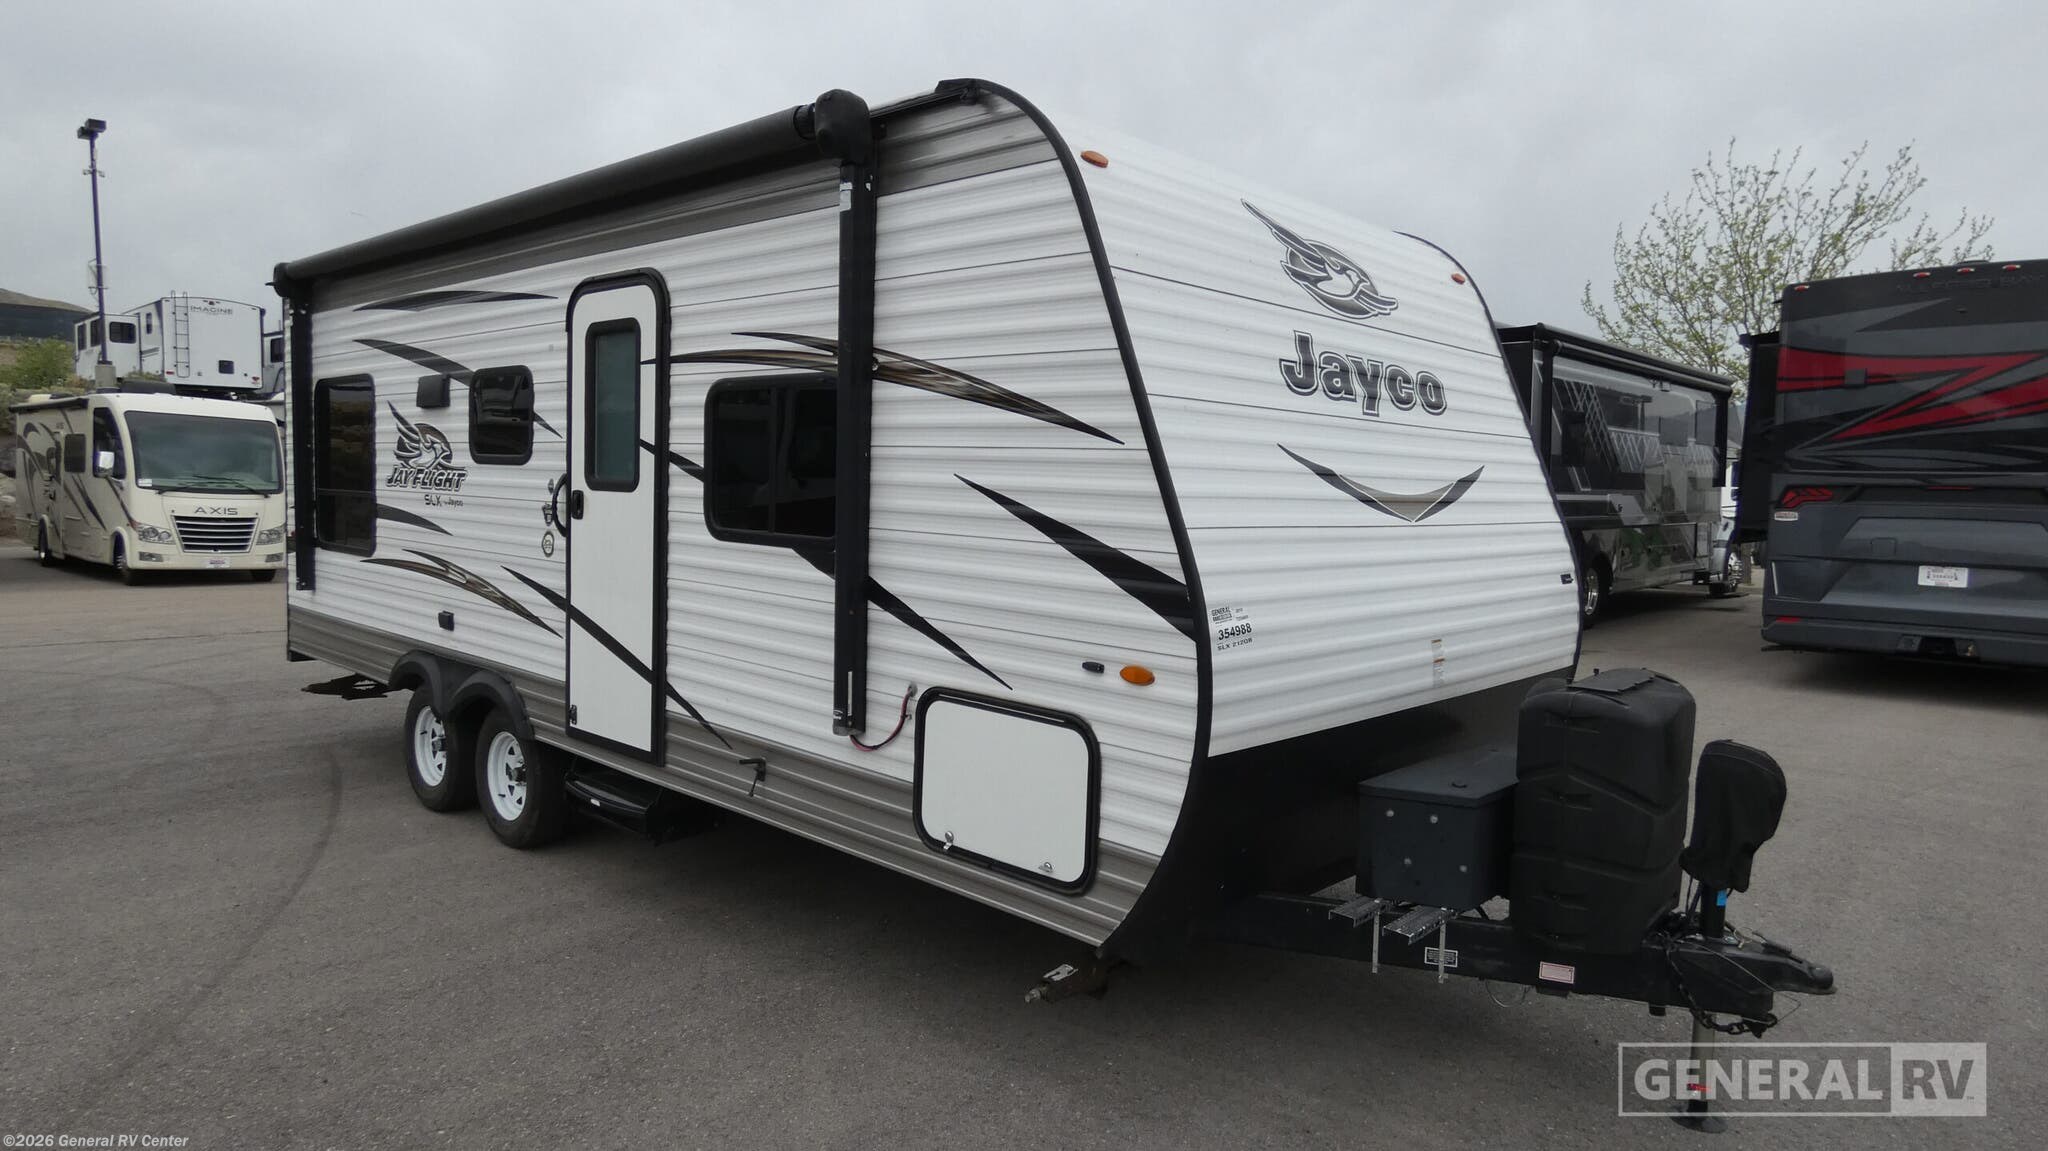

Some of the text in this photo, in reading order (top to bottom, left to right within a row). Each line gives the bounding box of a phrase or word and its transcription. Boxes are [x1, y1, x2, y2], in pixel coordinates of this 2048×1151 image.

[190, 305, 233, 315] IMAGINE
[1279, 330, 1447, 417] Jayco
[387, 465, 467, 492] JAY FLIGHT
[424, 494, 442, 507] SLX
[194, 506, 239, 515] AXIS
[1218, 623, 1252, 641] 354988
